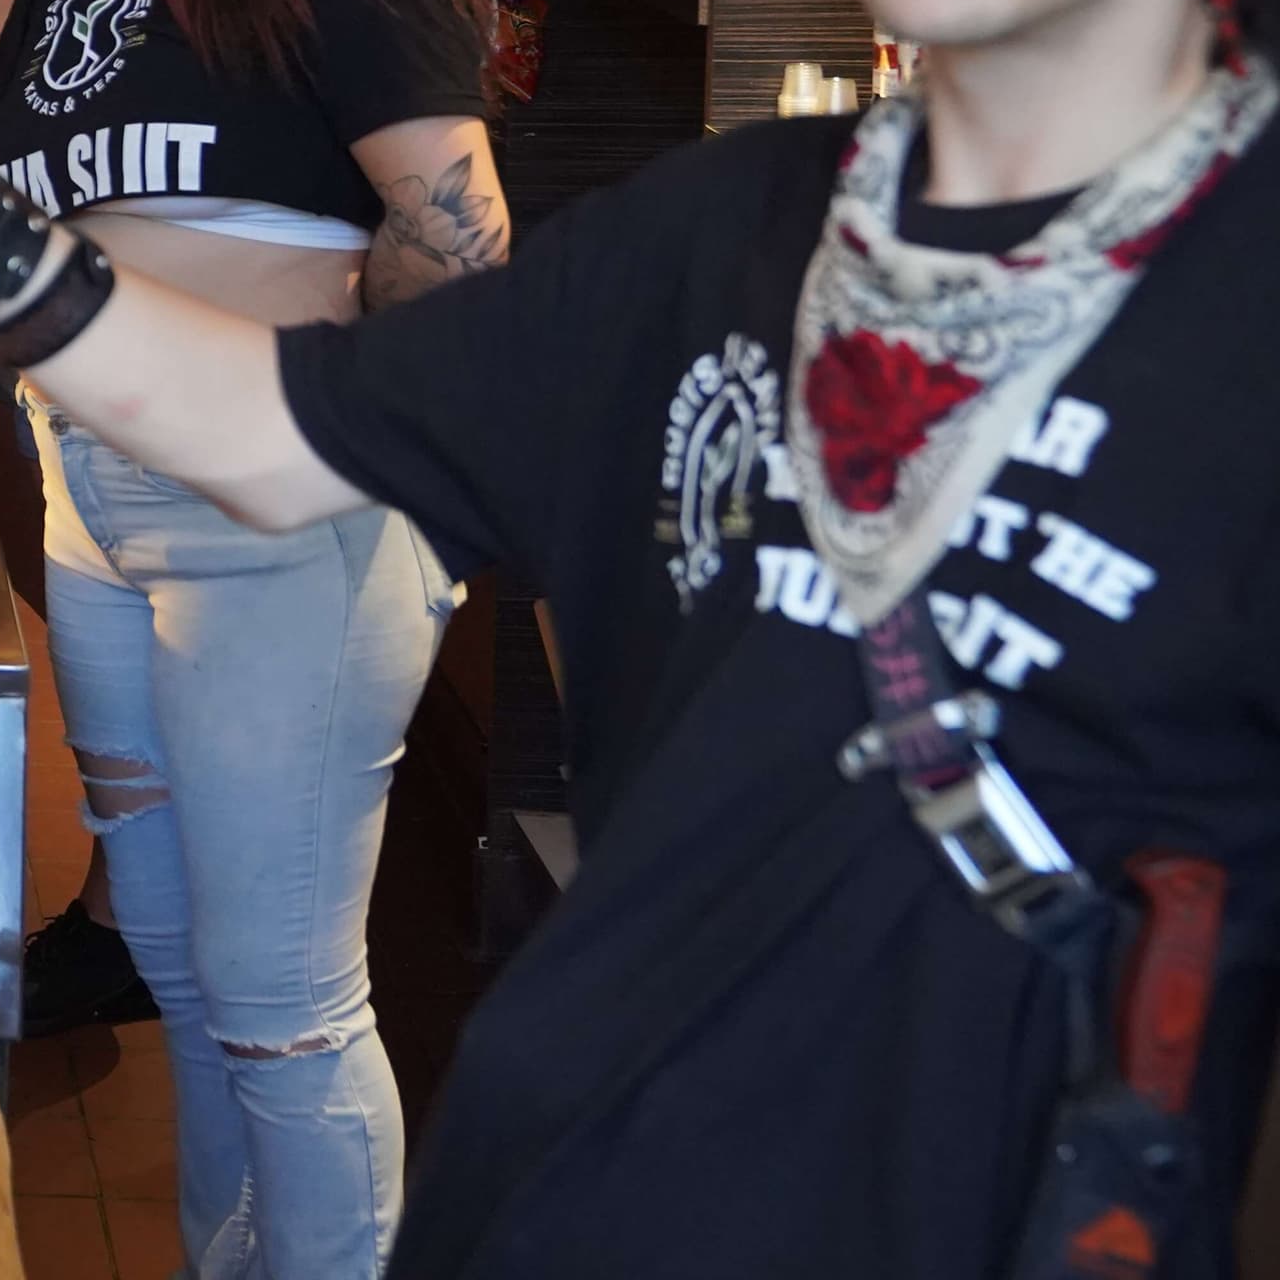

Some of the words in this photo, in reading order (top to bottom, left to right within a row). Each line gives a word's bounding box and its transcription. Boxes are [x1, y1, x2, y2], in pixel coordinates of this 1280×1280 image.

[24, 80, 60, 117] KAVAS
[63, 95, 75, 114] &
[82, 57, 125, 100] TEAS
[1030, 511, 1158, 621] THE
